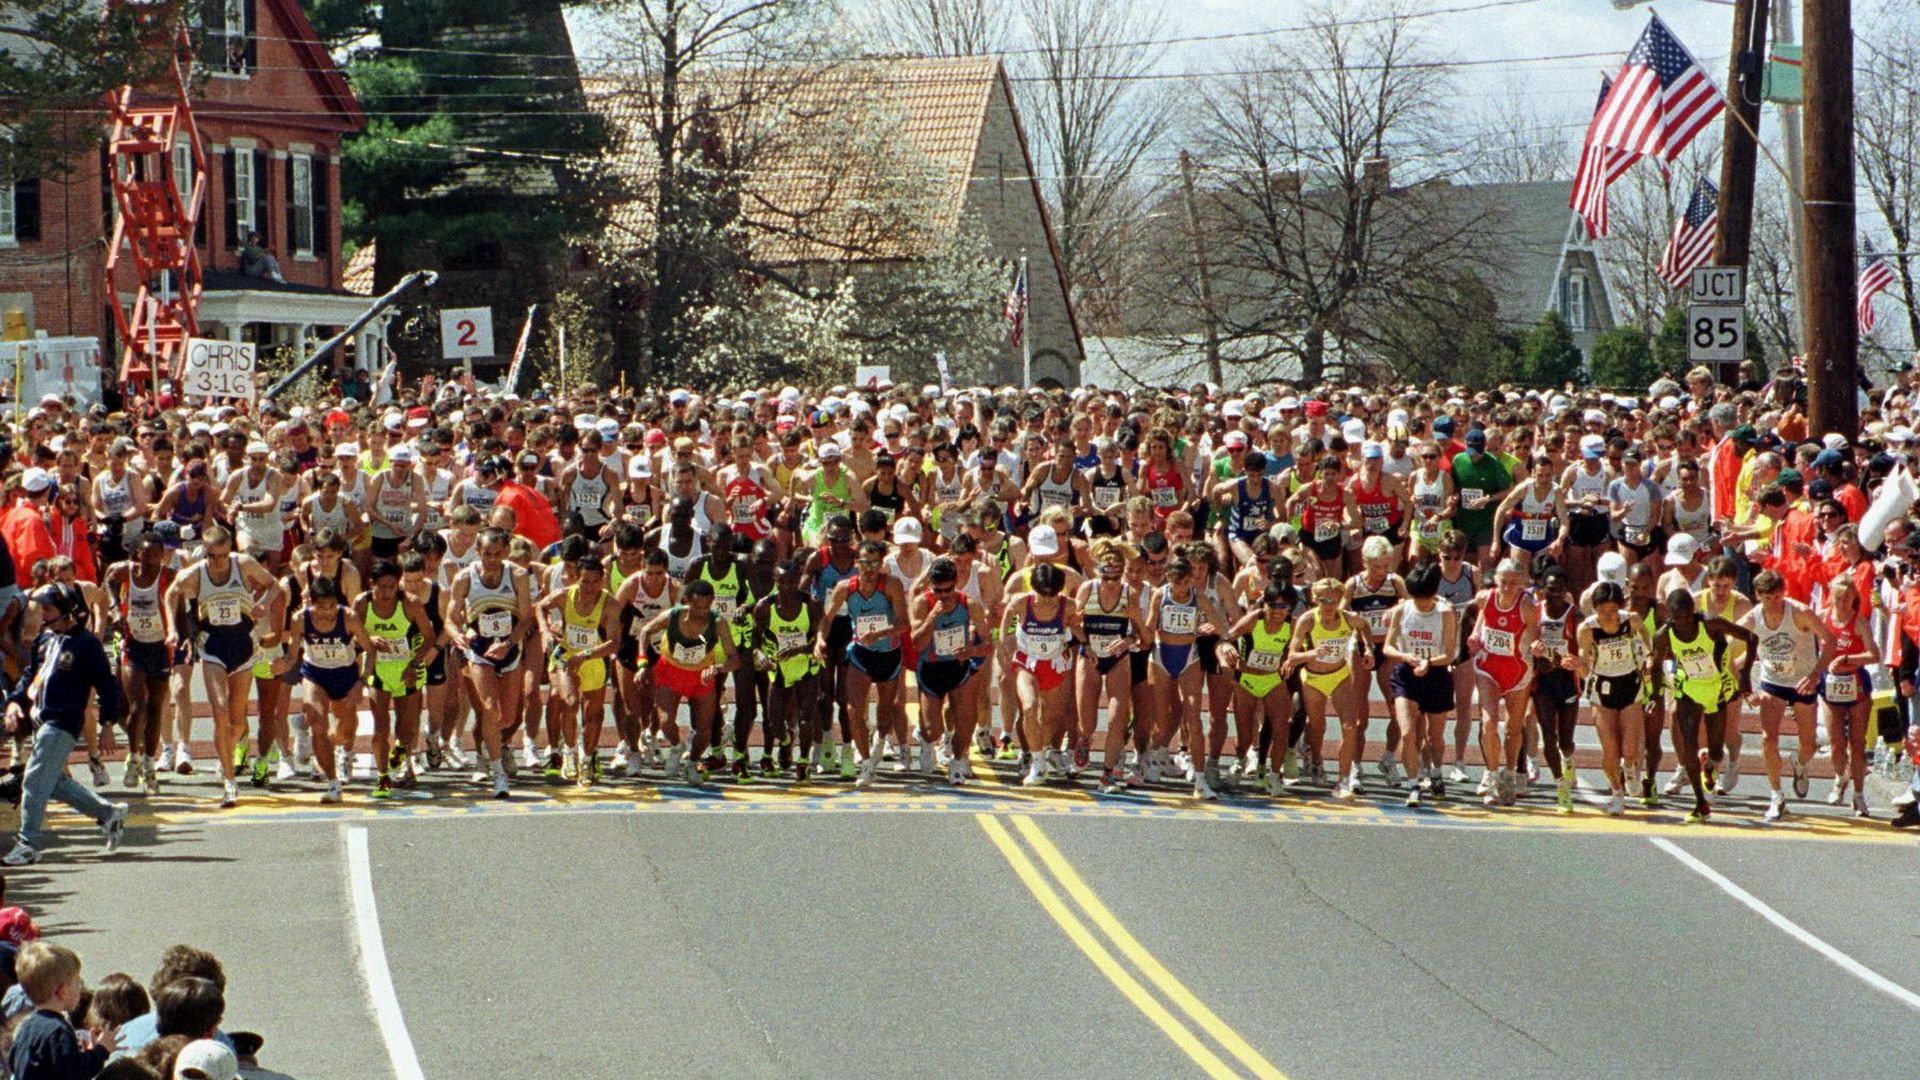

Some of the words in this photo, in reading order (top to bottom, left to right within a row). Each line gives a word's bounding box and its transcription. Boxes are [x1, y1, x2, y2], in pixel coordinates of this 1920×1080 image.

[1696, 272, 1737, 297] JCT
[456, 319, 477, 346] 2
[1694, 317, 1738, 348] 85
[191, 343, 251, 371] CHRIS
[197, 371, 246, 393] 3:16
[219, 607, 231, 618] 23
[139, 618, 152, 629] 25
[1170, 613, 1189, 626] F15
[374, 623, 397, 632] FILA
[576, 633, 588, 645] 10
[1487, 634, 1511, 648] F204
[1041, 642, 1048, 652] 9
[1256, 655, 1275, 665] F14
[1610, 648, 1622, 660] F6
[1695, 662, 1702, 672] 1
[1773, 662, 1785, 673] 36
[1833, 683, 1851, 695] F22
